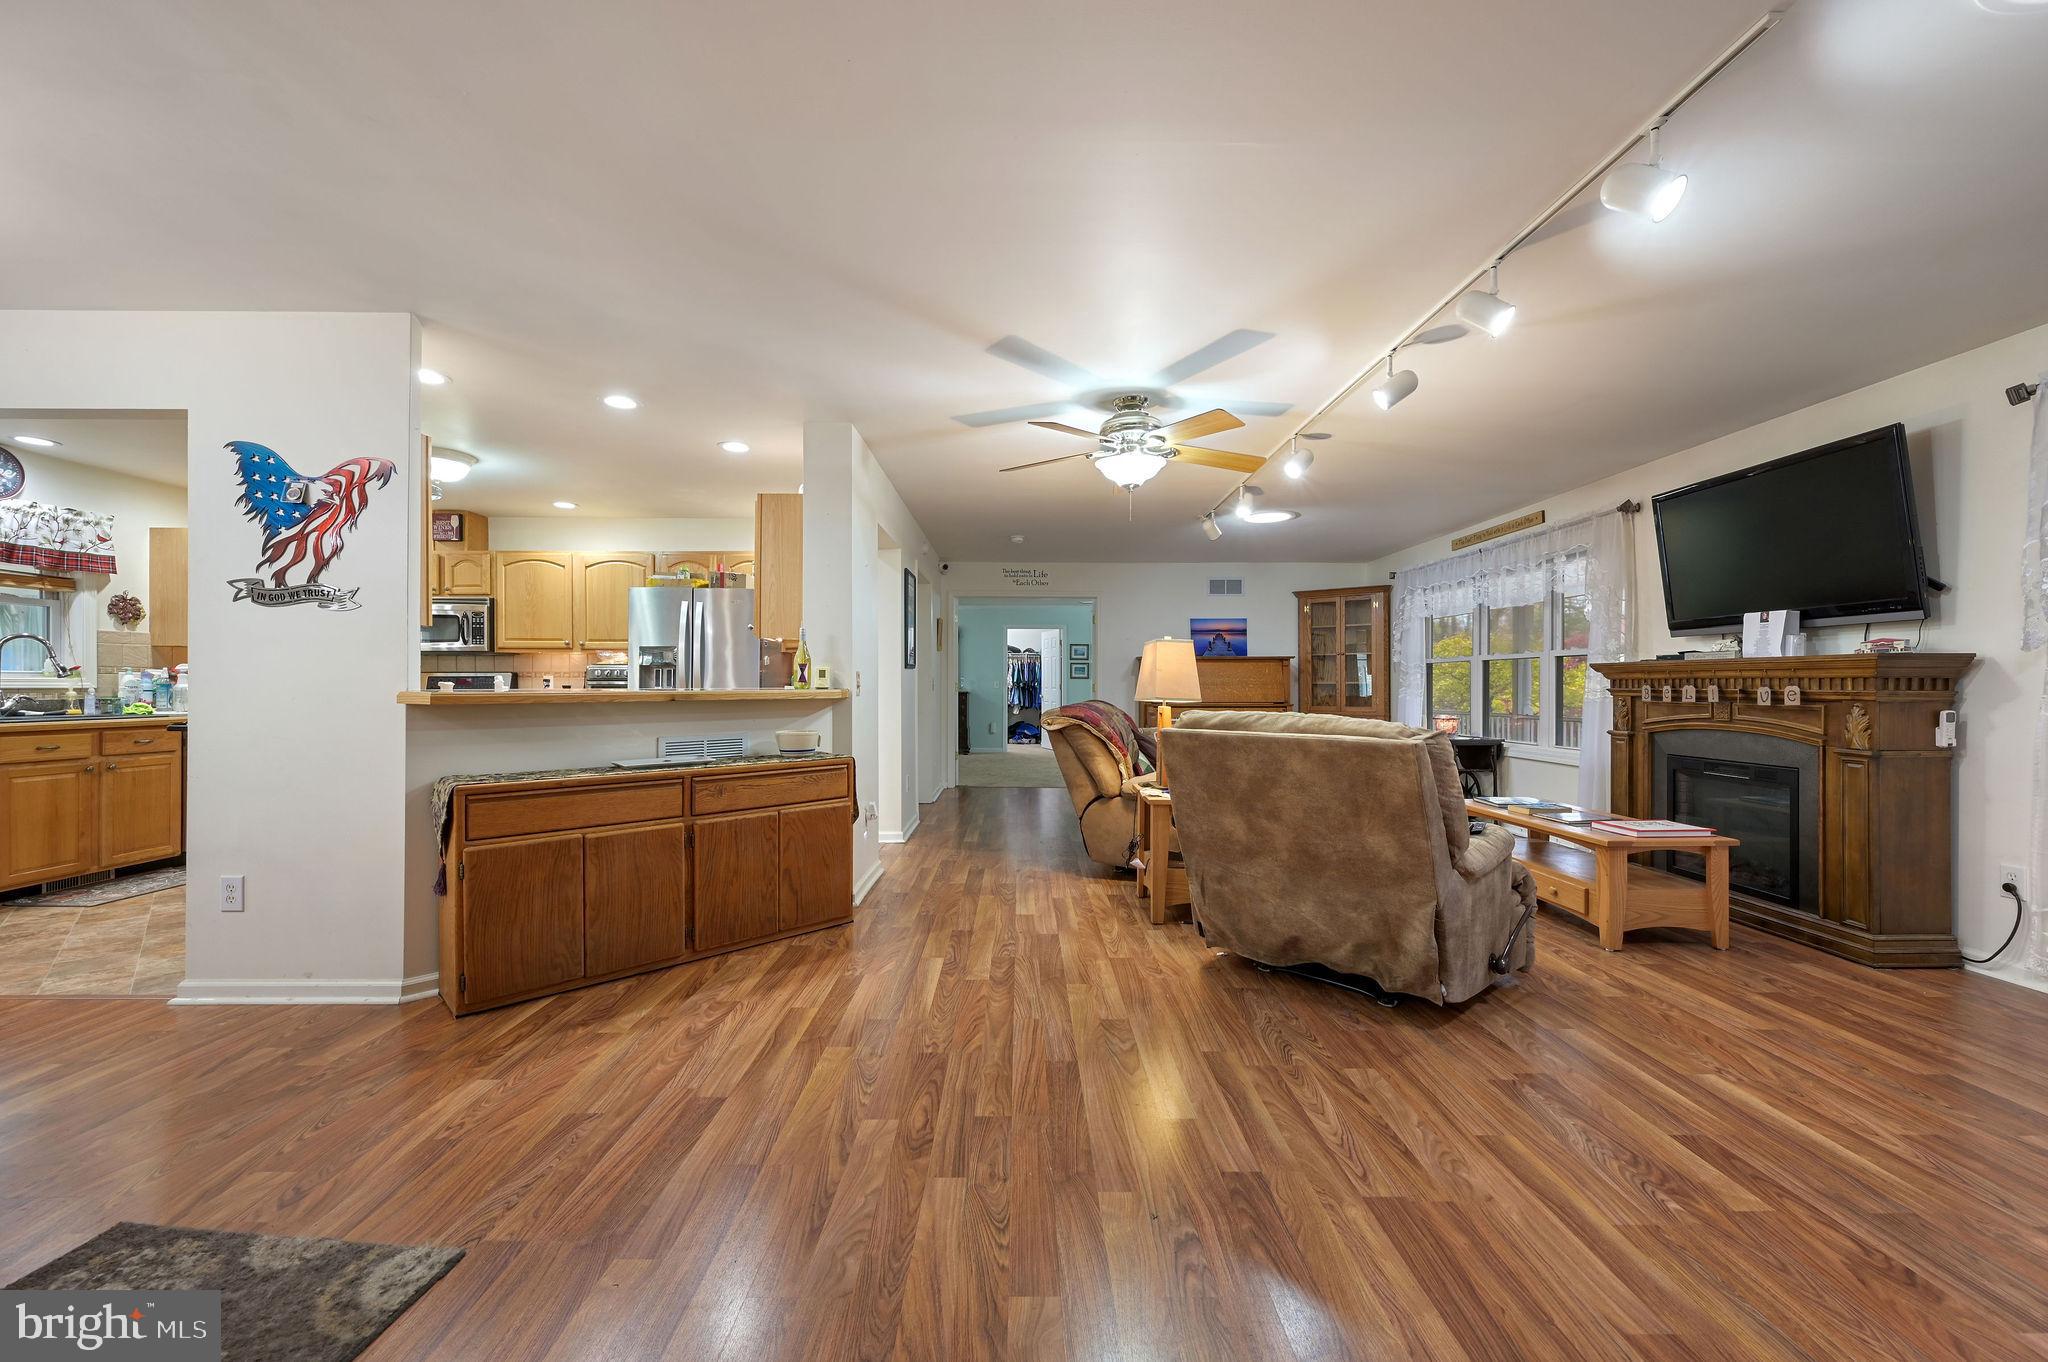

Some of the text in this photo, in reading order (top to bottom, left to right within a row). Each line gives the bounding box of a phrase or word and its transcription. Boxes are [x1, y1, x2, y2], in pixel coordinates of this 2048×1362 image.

[1033, 569, 1048, 577] Life
[256, 588, 332, 601] IN GOD WE TRUST
